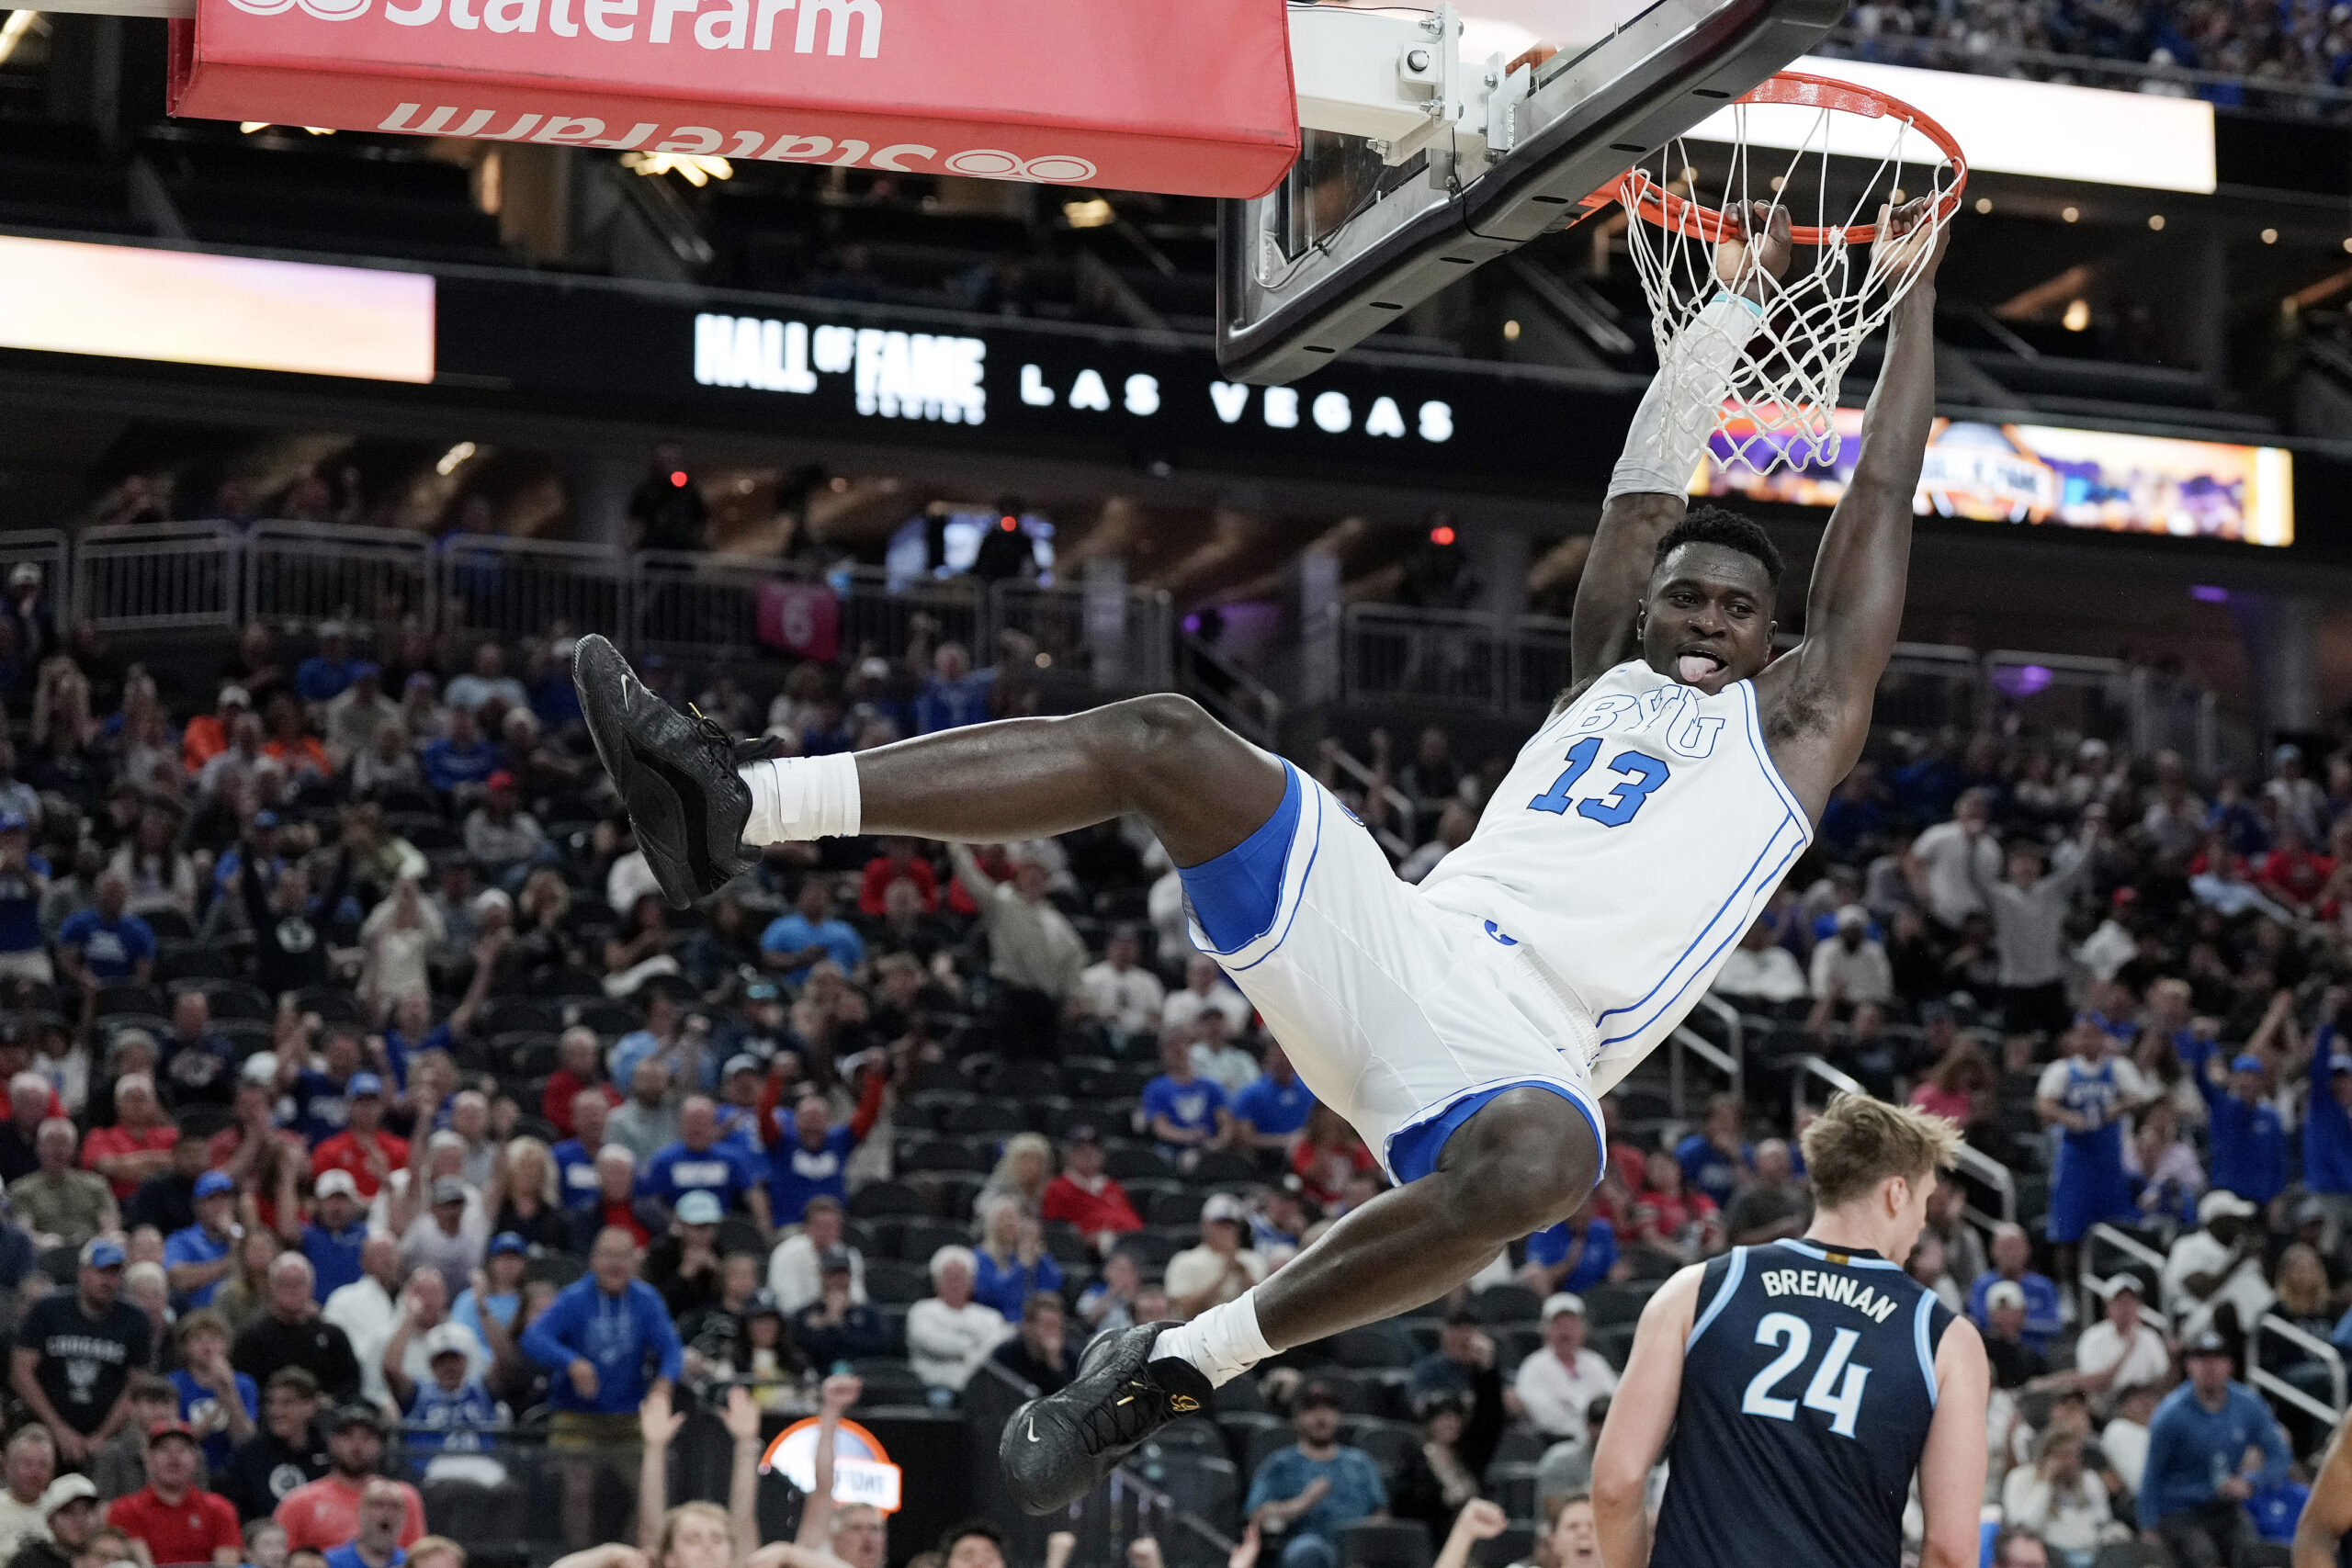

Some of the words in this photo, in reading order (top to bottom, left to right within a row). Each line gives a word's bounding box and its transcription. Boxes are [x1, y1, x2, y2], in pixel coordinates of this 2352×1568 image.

[695, 314, 817, 393] HALL
[813, 325, 855, 373] OF
[855, 329, 986, 406] FAME
[1022, 365, 1159, 414] LAS
[1211, 382, 1453, 441] VEGAS
[1557, 683, 1725, 759] BYU
[1527, 738, 1670, 828] 13
[1761, 1269, 1897, 1323] BRENNAN
[1742, 1313, 1872, 1438] 24
